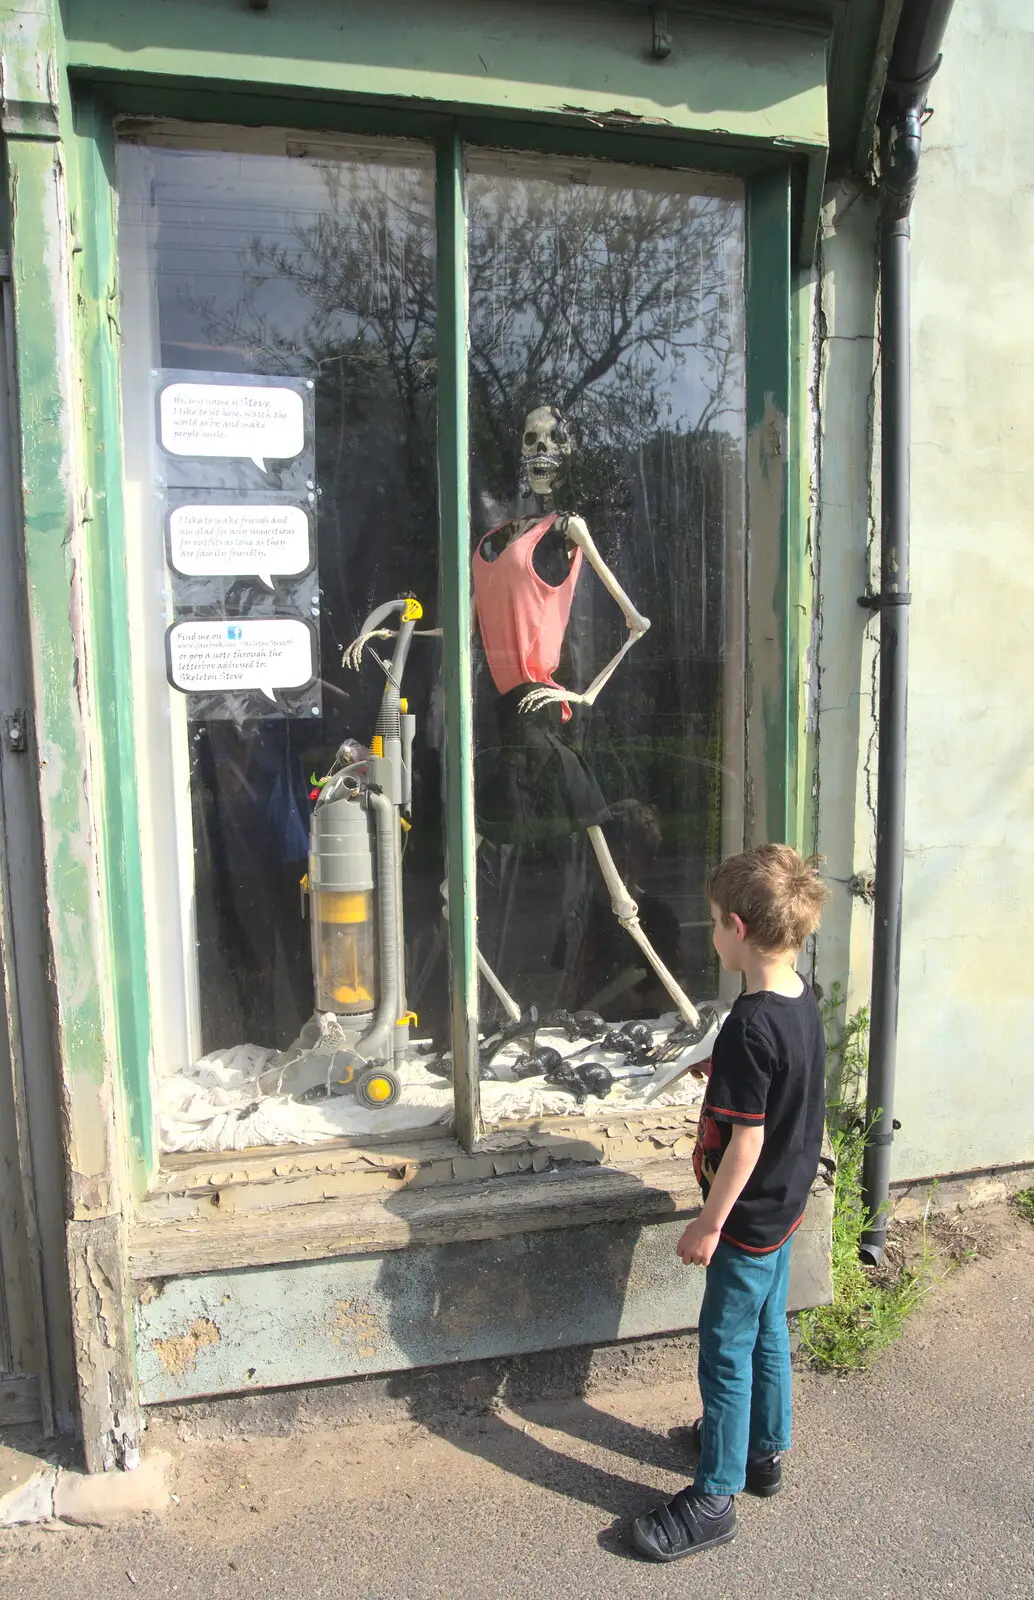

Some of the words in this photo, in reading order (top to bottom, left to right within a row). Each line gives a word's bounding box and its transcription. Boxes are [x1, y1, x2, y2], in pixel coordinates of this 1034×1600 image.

[179, 407, 197, 416] like
[199, 408, 208, 416] to
[244, 408, 272, 418] watch
[273, 410, 288, 419] the
[173, 417, 198, 426] world
[222, 419, 240, 429] and
[241, 420, 266, 429] make
[173, 429, 199, 440] people
[184, 515, 203, 525] like
[204, 515, 213, 525] to
[214, 516, 239, 525] make
[239, 515, 269, 528] friends
[270, 515, 288, 525] and
[249, 527, 295, 538] suggestions
[179, 538, 191, 549] for
[193, 538, 223, 549] outfits
[266, 537, 286, 549] they
[180, 549, 194, 558] are
[195, 548, 227, 561] family
[176, 632, 196, 641] Find
[198, 633, 210, 641] me
[211, 632, 222, 640] on
[179, 652, 188, 660] or
[188, 652, 203, 664] pop
[213, 651, 231, 659] note
[233, 648, 267, 661] through
[269, 648, 283, 657] the
[178, 660, 216, 671] letterbox
[217, 659, 254, 670] addressed
[179, 672, 217, 682] Skeleton
[219, 671, 244, 681] Steve
